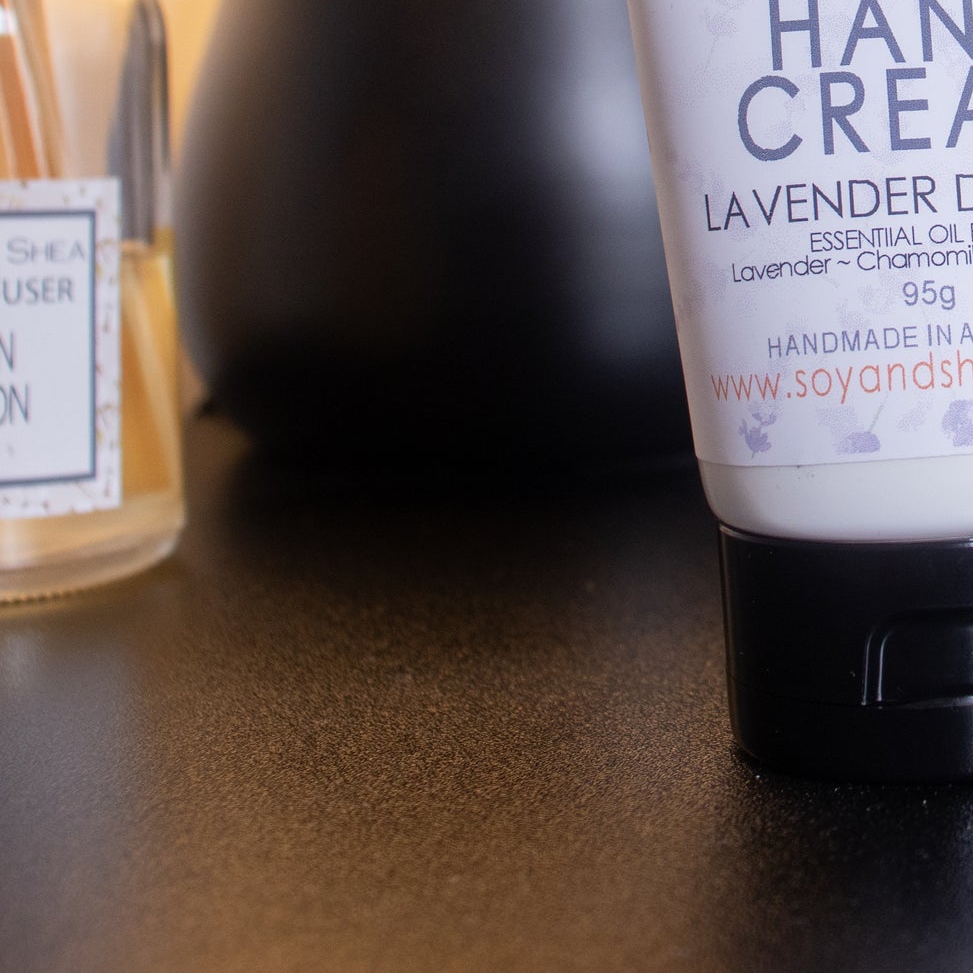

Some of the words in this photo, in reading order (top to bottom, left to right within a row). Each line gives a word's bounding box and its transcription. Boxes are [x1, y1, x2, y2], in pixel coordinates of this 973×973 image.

[704, 175, 938, 232] LAVENDER
[929, 224, 965, 244] OIL
[732, 255, 831, 283] Lavender
[901, 280, 956, 310] 95g
[767, 328, 917, 358] HANDMADE
[927, 325, 952, 346] IN
